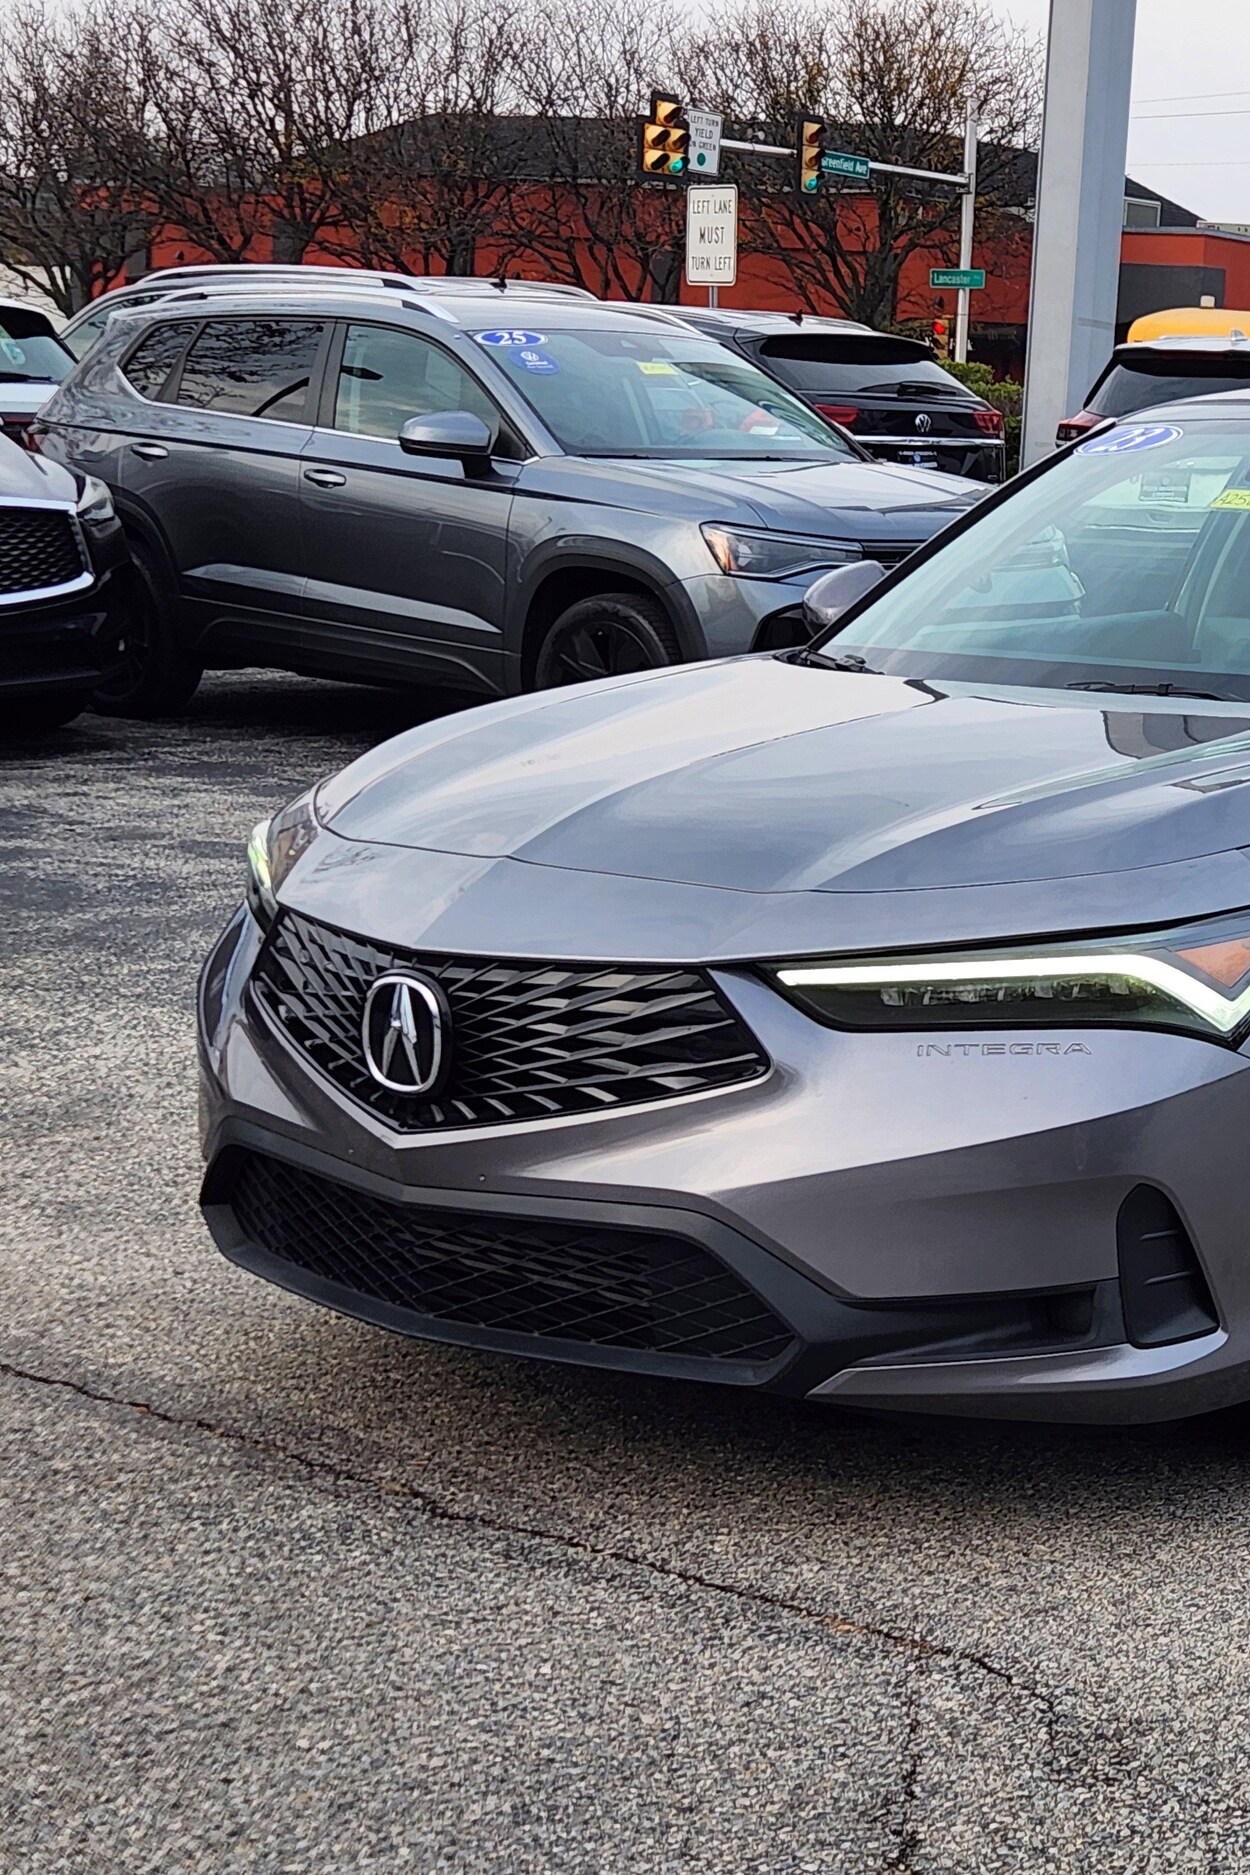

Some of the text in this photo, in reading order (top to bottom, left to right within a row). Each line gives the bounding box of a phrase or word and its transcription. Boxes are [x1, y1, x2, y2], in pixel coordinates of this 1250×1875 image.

[691, 114, 703, 124] LEFT
[695, 127, 713, 139] YIELD
[855, 161, 867, 174] Ave
[692, 200, 732, 214] LEFT LANE
[699, 226, 725, 244] MUST
[691, 256, 732, 271] TURN LEFT
[934, 272, 971, 284] Lancaster
[496, 331, 527, 345] 25
[1088, 428, 1166, 452] 23
[916, 1042, 1093, 1057] INTEGRA
